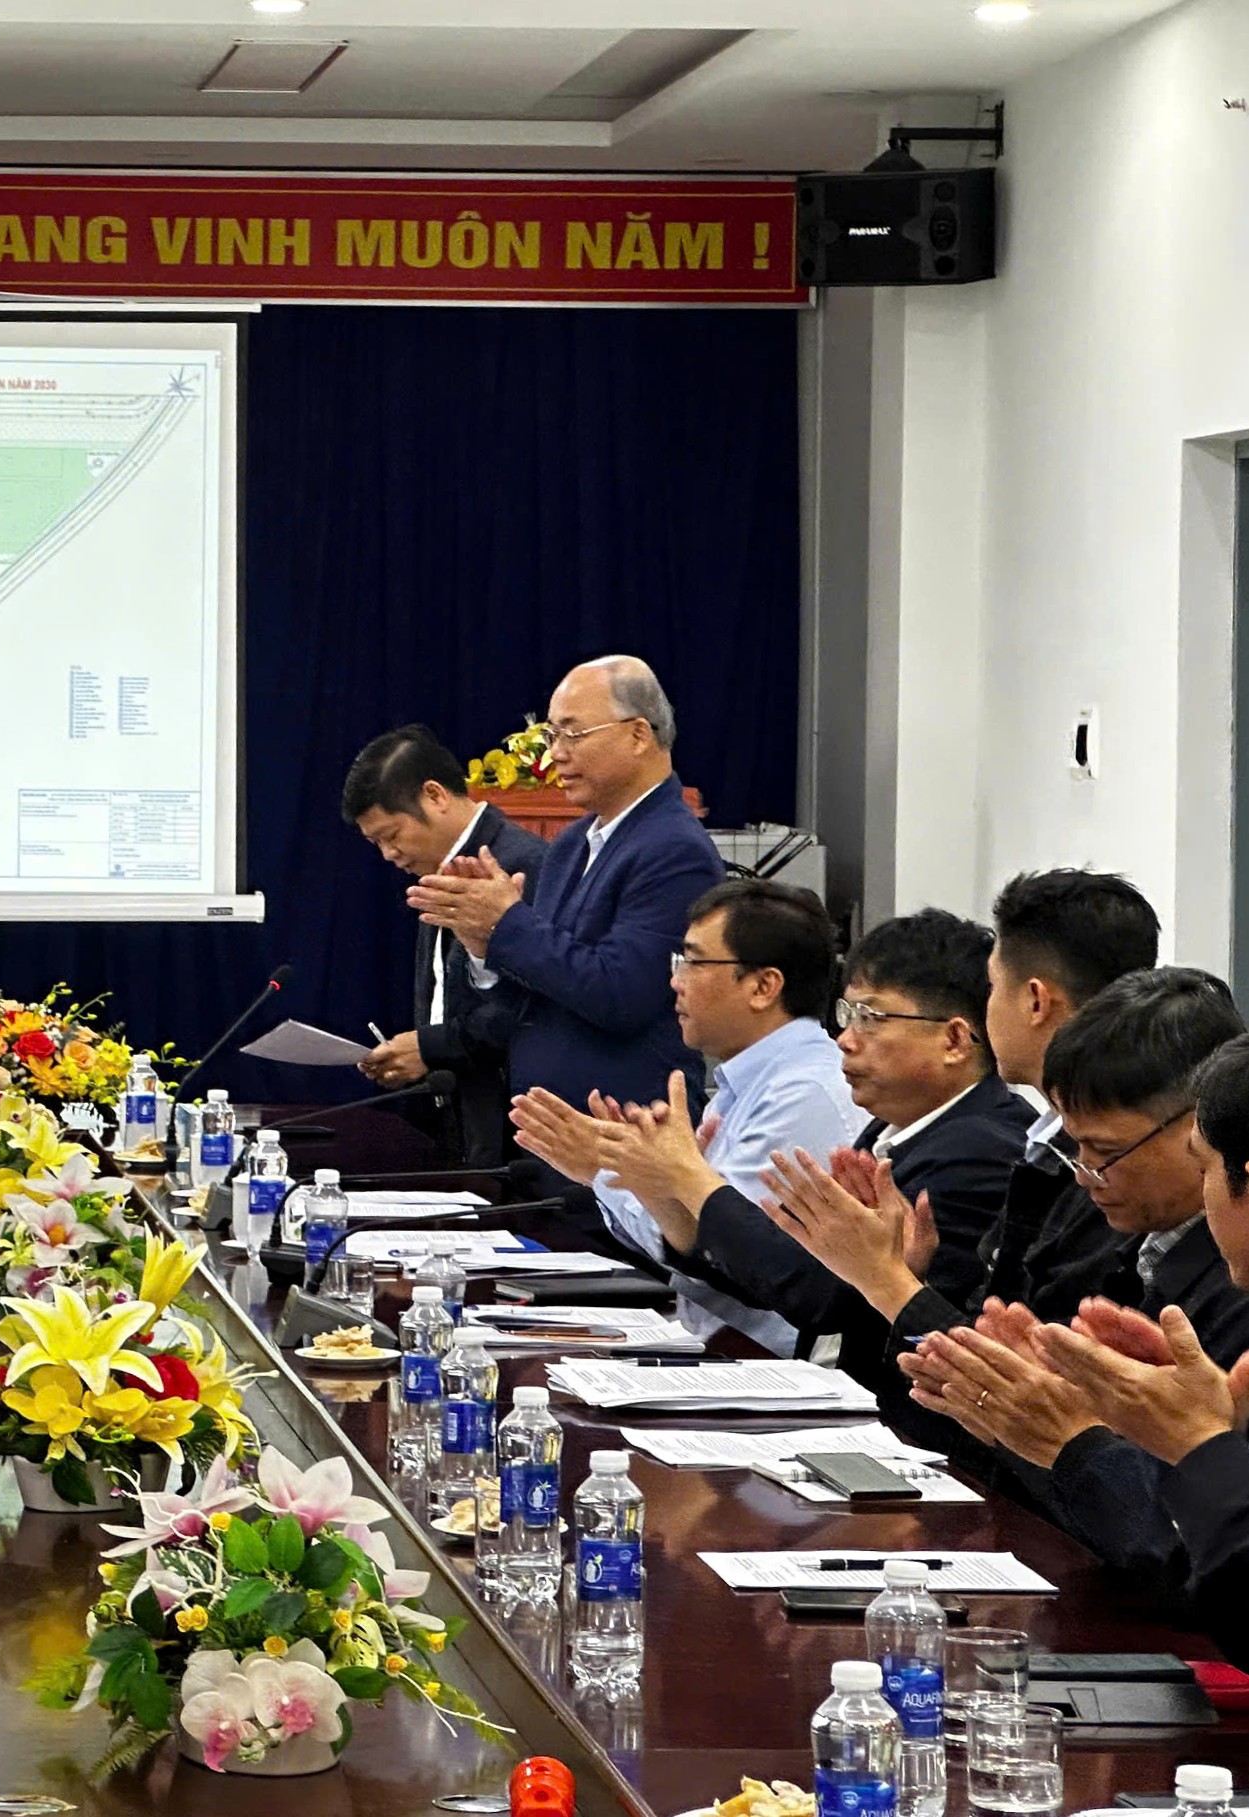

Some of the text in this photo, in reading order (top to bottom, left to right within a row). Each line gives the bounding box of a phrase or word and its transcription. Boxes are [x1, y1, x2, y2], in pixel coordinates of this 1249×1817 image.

[150, 216, 312, 267] VINH
[335, 210, 542, 269] MUÔN
[565, 212, 724, 270] NĂM
[752, 222, 770, 269] !
